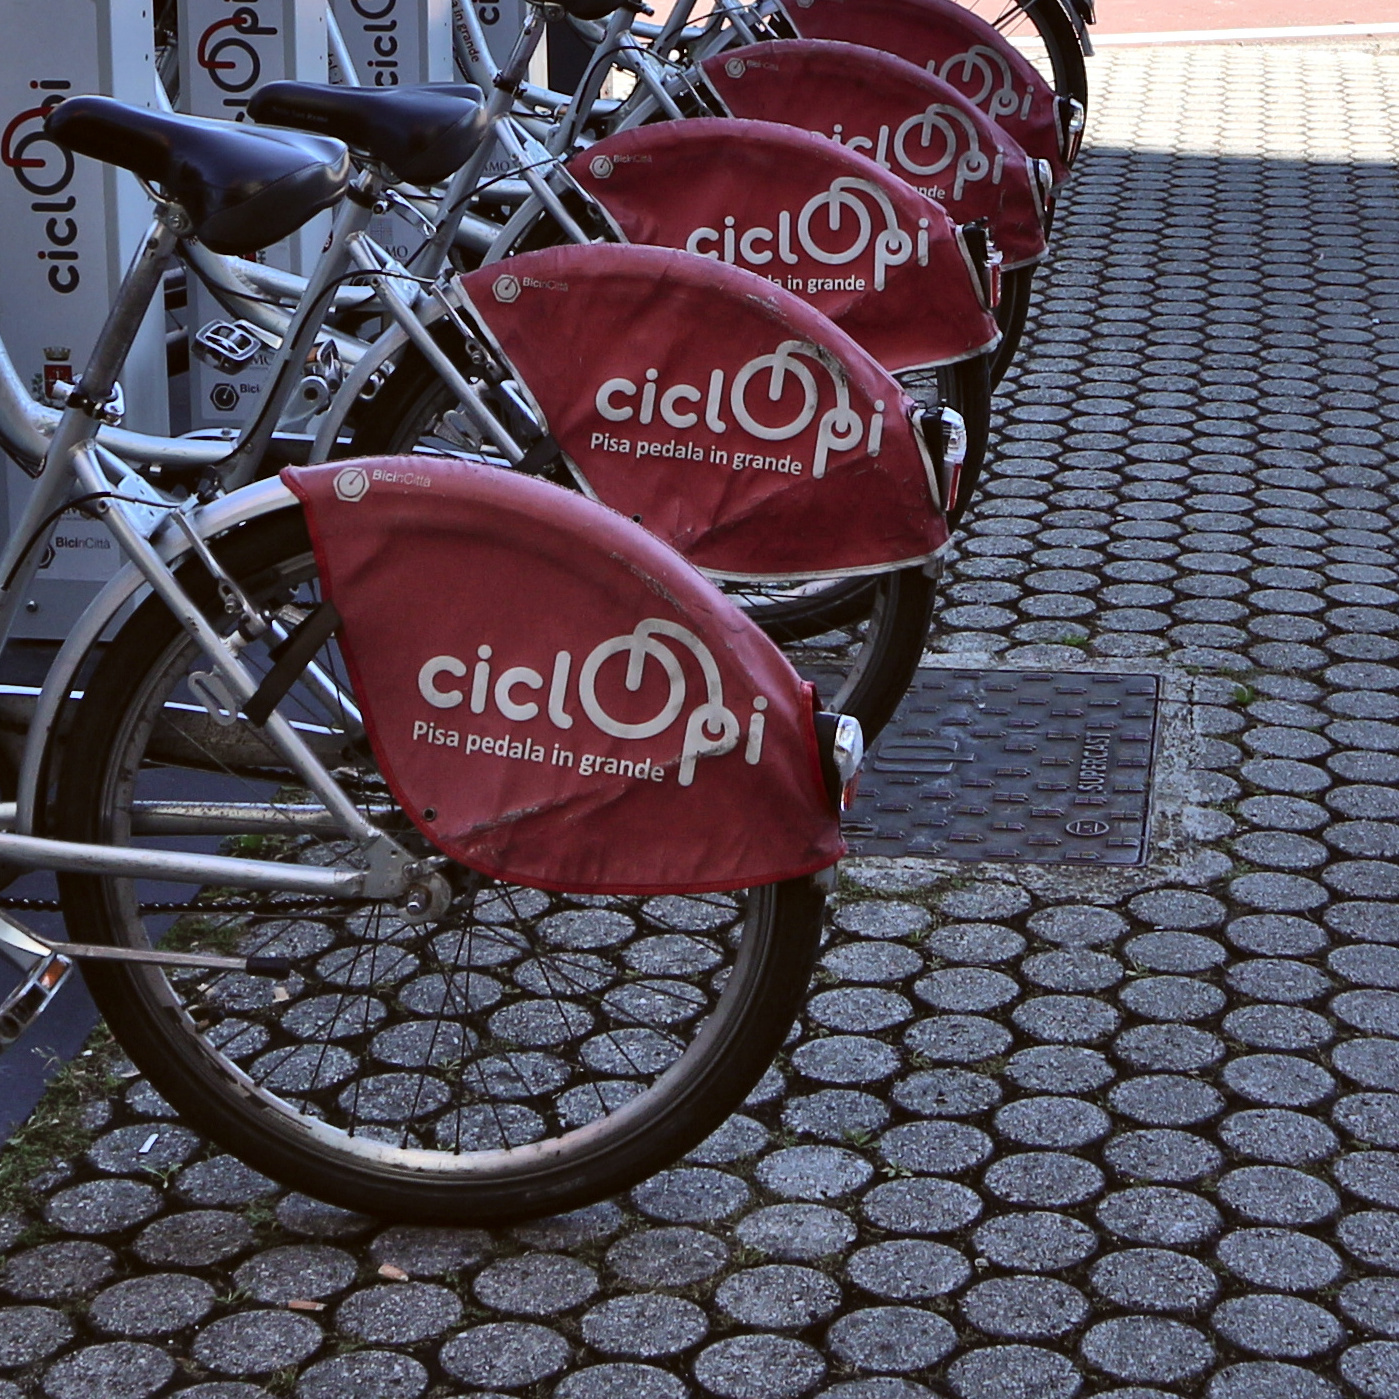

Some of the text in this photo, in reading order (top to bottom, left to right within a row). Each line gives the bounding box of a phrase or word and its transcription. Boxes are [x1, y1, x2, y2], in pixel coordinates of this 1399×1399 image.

[456, 23, 480, 63] grande
[787, 274, 803, 290] in
[806, 274, 866, 294] grande
[590, 432, 803, 476] Pisa pedala in grande
[412, 720, 666, 783] Pisa pedala in grande
[1077, 731, 1111, 791] SUPERCAST
